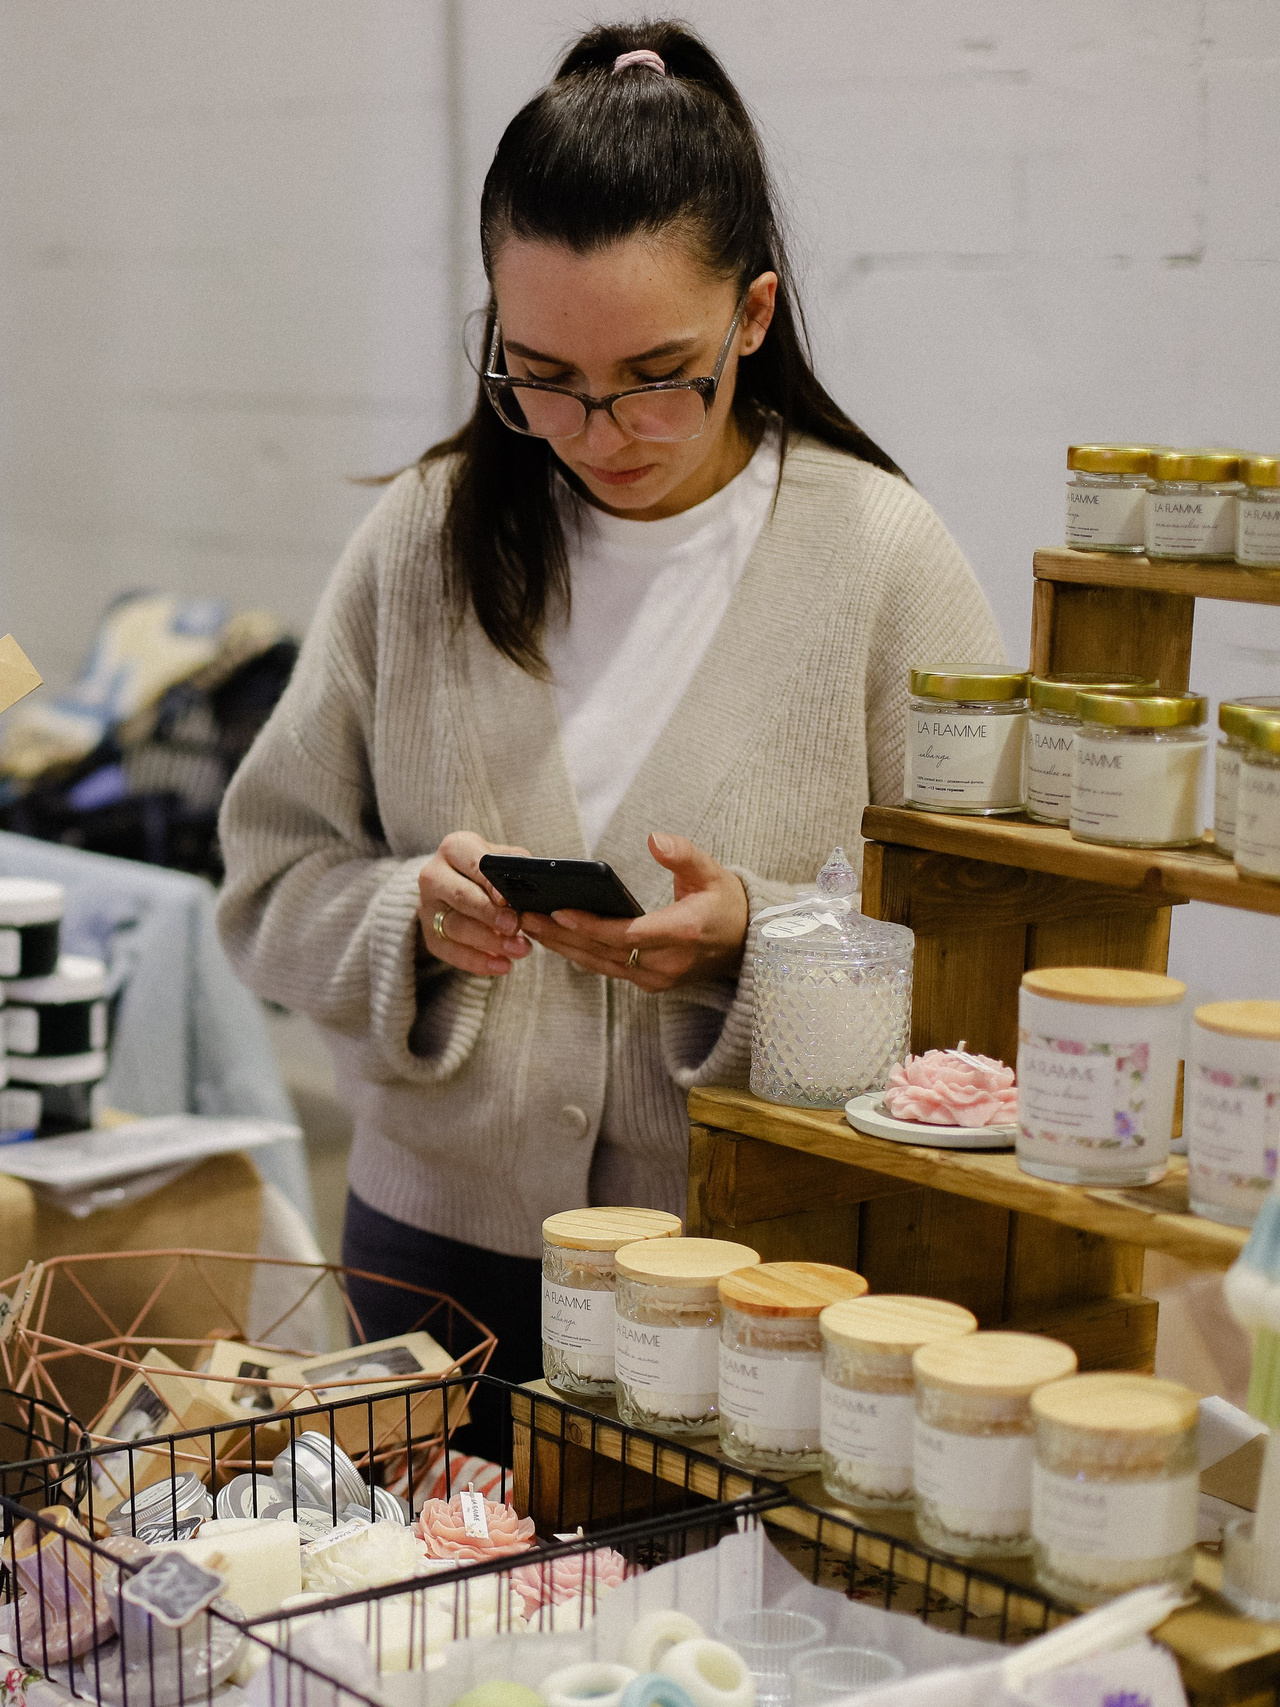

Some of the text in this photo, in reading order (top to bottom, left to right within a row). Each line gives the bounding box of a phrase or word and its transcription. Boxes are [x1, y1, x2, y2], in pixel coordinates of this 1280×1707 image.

[1154, 503, 1203, 514] LA FLAMME
[917, 721, 987, 738] LA FLAMME
[552, 1291, 592, 1311] FLAMME
